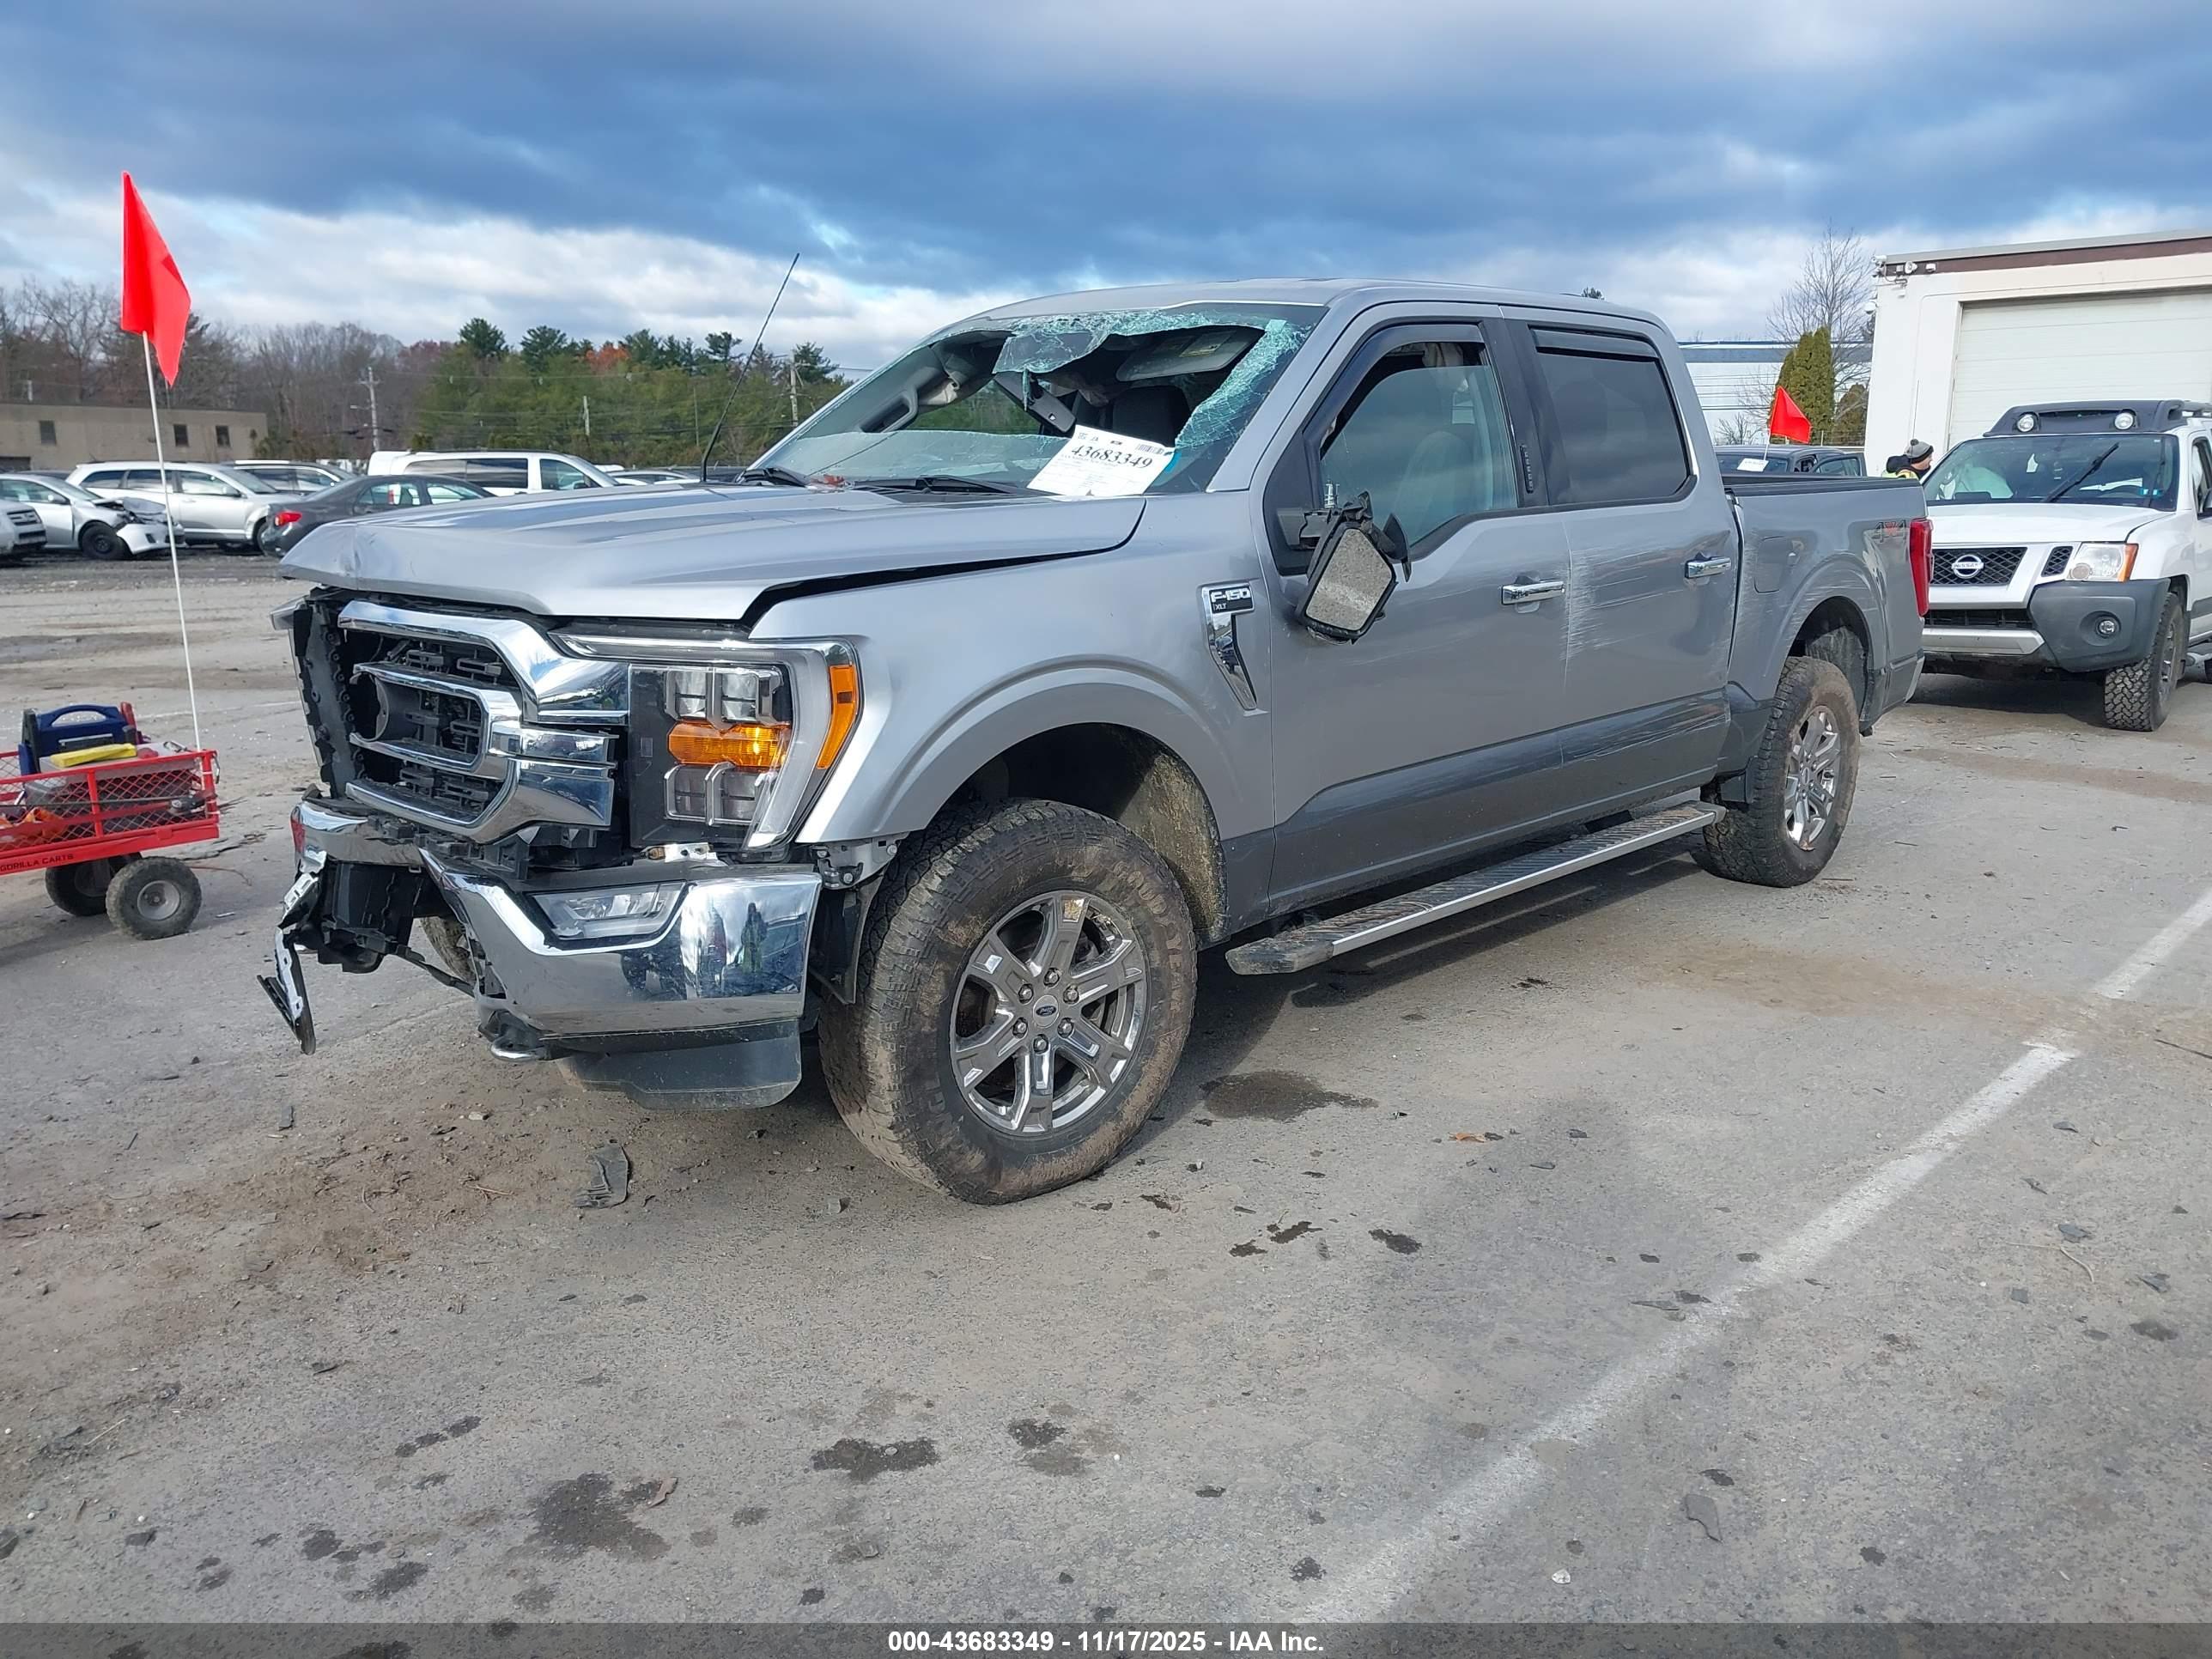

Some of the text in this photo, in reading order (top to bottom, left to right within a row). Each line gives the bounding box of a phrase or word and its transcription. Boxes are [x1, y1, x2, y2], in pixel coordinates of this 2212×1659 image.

[1071, 445, 1152, 469] 43683349
[1211, 588, 1251, 603] F-150
[0, 854, 75, 872] GORILLA CARTS
